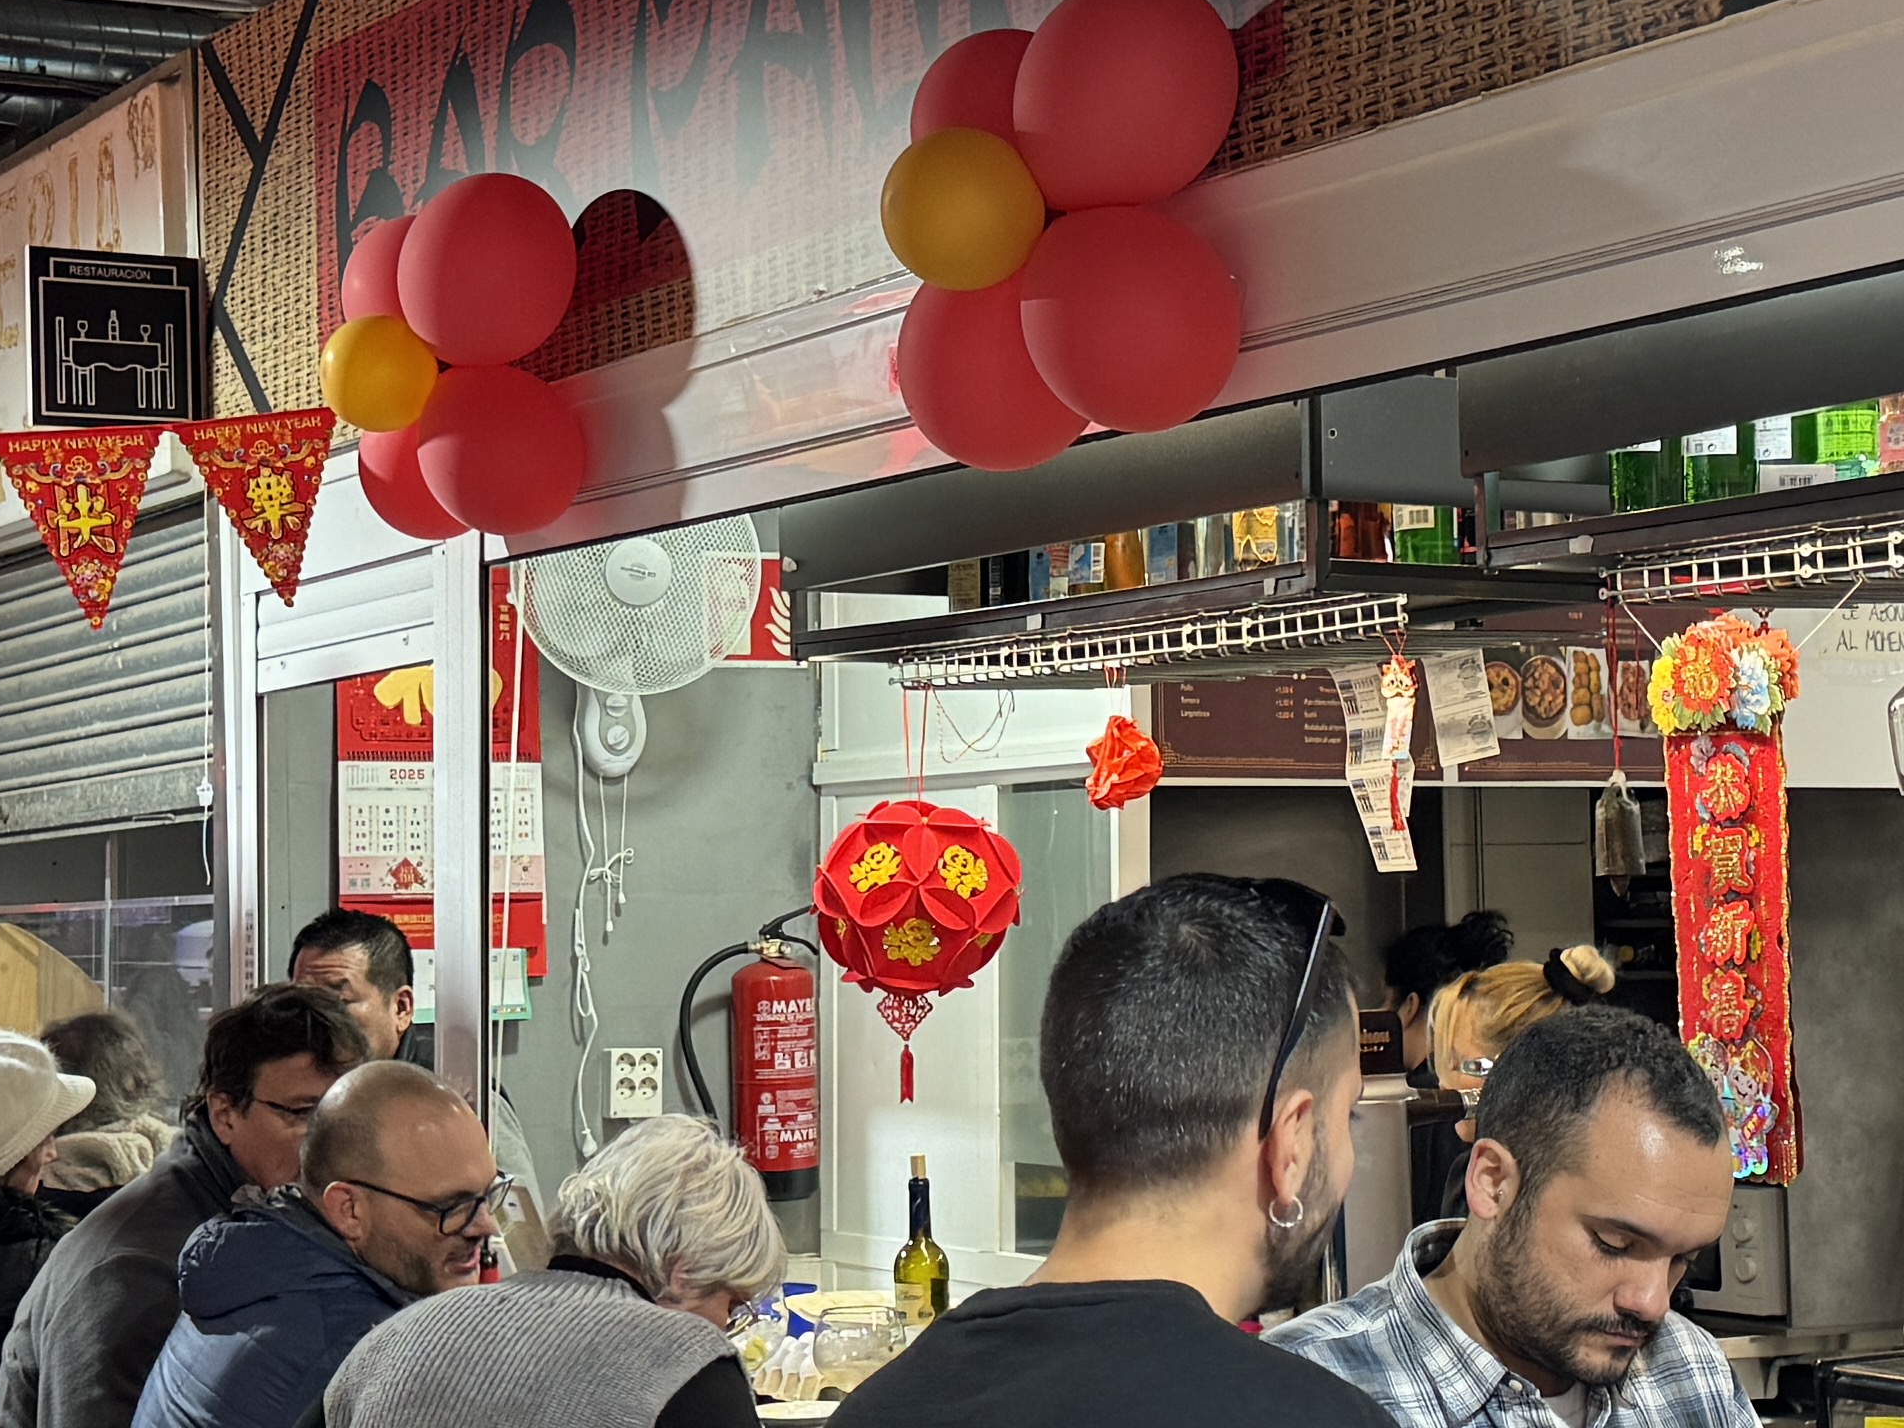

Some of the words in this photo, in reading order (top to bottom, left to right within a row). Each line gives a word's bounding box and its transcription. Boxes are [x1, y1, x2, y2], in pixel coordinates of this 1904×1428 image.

[69, 264, 151, 282] RESTAURACIÓN
[193, 424, 244, 442] HAPPY
[246, 420, 284, 435] NEW
[283, 415, 323, 432] YEAR
[8, 438, 62, 453] HAPPY
[64, 437, 102, 450] NEW
[101, 434, 145, 447] YEAR
[1836, 630, 1858, 652] AL
[389, 768, 425, 780] 2025
